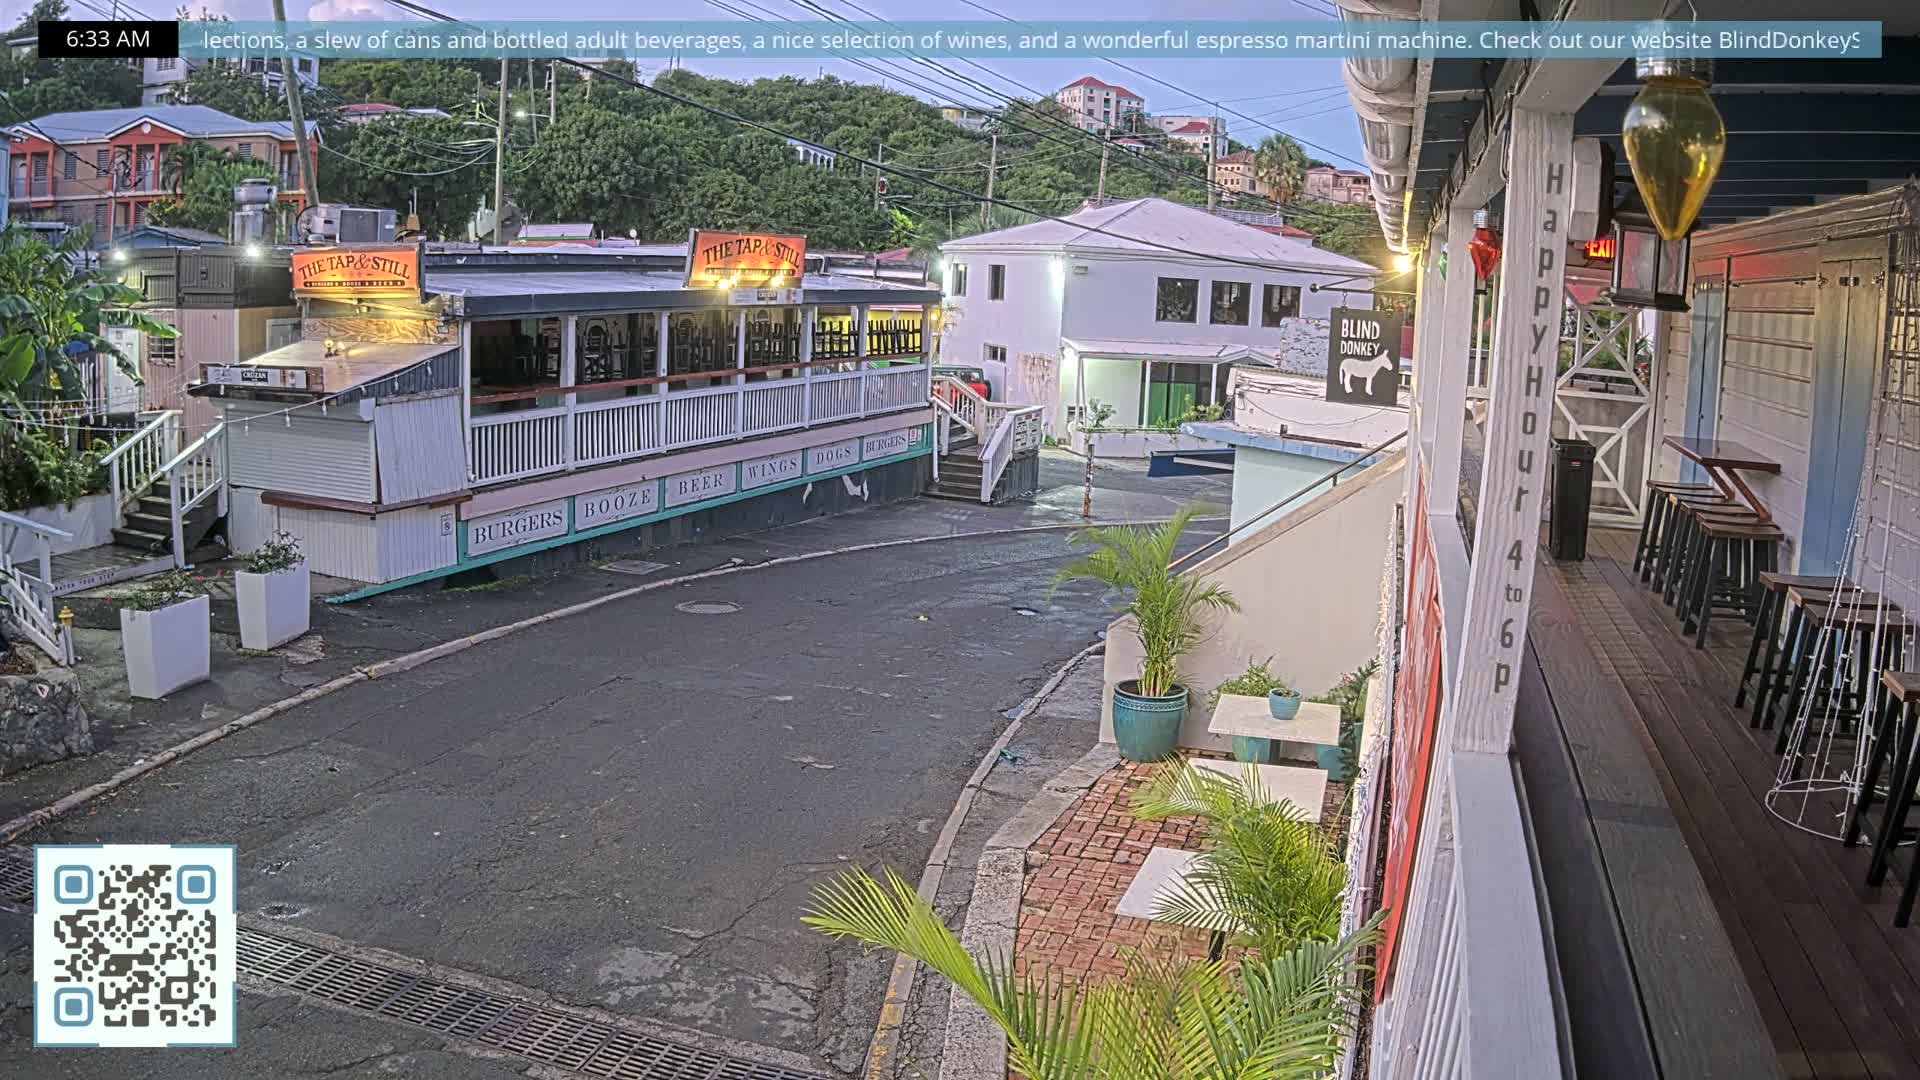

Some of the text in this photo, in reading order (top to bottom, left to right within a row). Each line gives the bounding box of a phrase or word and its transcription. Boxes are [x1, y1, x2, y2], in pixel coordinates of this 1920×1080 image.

[702, 238, 801, 269] THE TAP & STILL
[1532, 162, 1565, 355] Happy
[298, 253, 411, 280] THE TAP & STILL
[1341, 318, 1381, 340] BLIND
[1340, 340, 1381, 356] DONKEY
[242, 370, 267, 379] CRUZAN
[865, 433, 907, 454] BURGERS
[1514, 365, 1543, 513] Hour
[816, 447, 852, 466] DOGS
[748, 458, 798, 481] WINGS
[678, 473, 724, 496] BEER
[584, 487, 652, 519] BOOZE
[474, 509, 564, 545] BURGERS
[1507, 539, 1523, 571] 4
[1504, 583, 1523, 603] to
